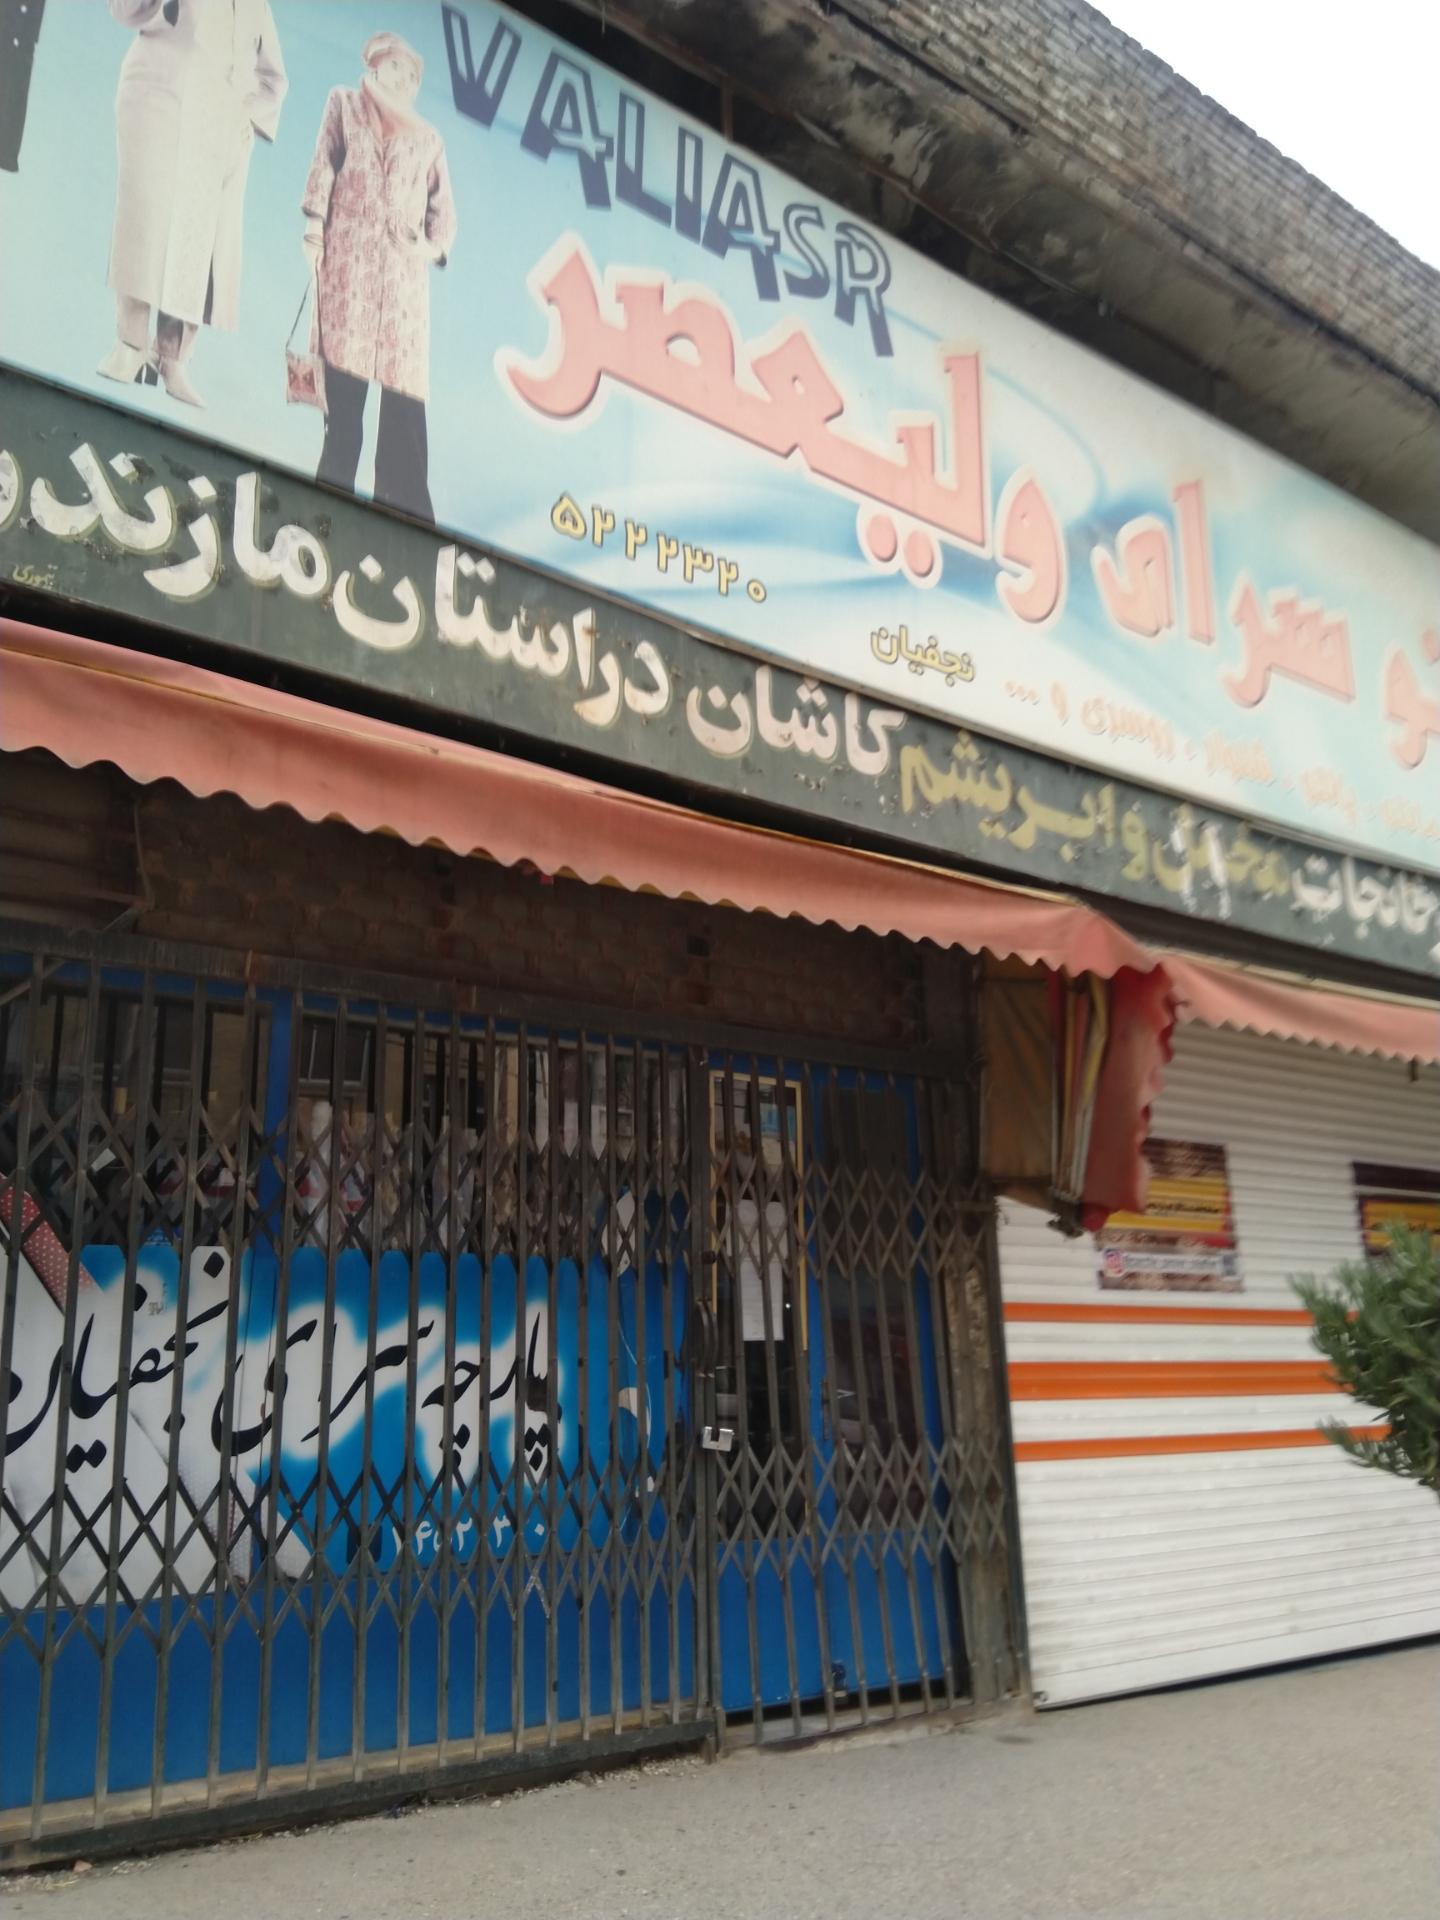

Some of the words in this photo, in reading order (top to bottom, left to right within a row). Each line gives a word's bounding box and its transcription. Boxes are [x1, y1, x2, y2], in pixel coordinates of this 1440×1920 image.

[441, 2, 894, 357] VALIASR
[506, 248, 1061, 623] ولیعصر
[550, 491, 767, 603] ۵۲۲۲۳۲۰
[1097, 478, 1356, 708] سرای
[685, 663, 908, 777] کاشان
[870, 624, 975, 688] نجفیان
[900, 726, 1116, 865] ابریشم
